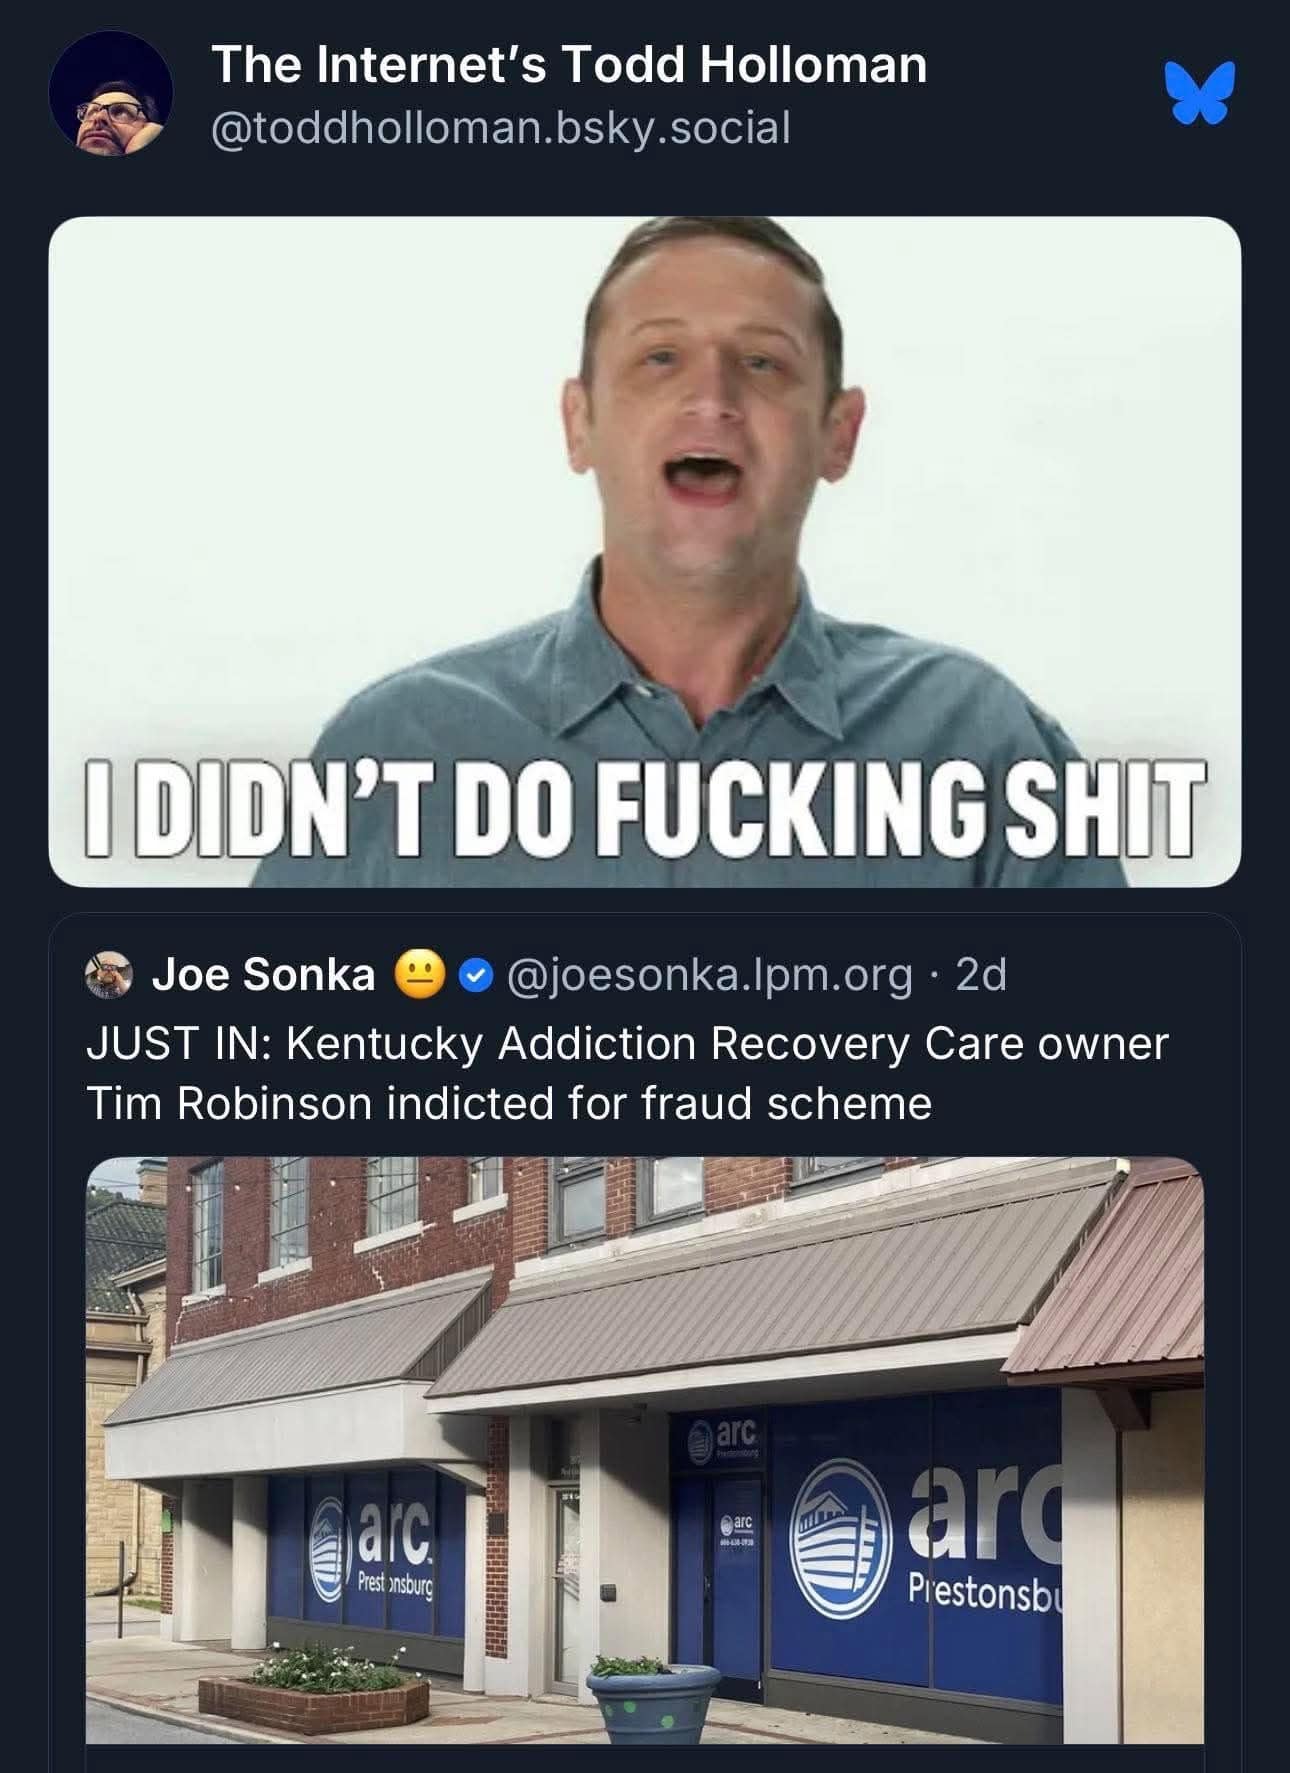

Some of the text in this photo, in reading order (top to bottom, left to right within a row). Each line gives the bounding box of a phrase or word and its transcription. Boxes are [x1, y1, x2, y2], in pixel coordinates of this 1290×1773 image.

[211, 44, 927, 84] The Internet’s Todd Holloman
[212, 108, 790, 153] @toddholloman.bsky.social
[151, 955, 1006, 1001] Joe Sonka @joesonka.lpm.org 2d
[86, 1024, 1170, 1070] JUST IN: Kentucky Addiction Recovery Care owner
[86, 1084, 932, 1121] Tim Robinson indicted for fraud scheme
[717, 1420, 756, 1446] arc
[359, 1502, 430, 1565] arc
[734, 1516, 753, 1529] arc
[908, 1463, 1063, 1565] arc
